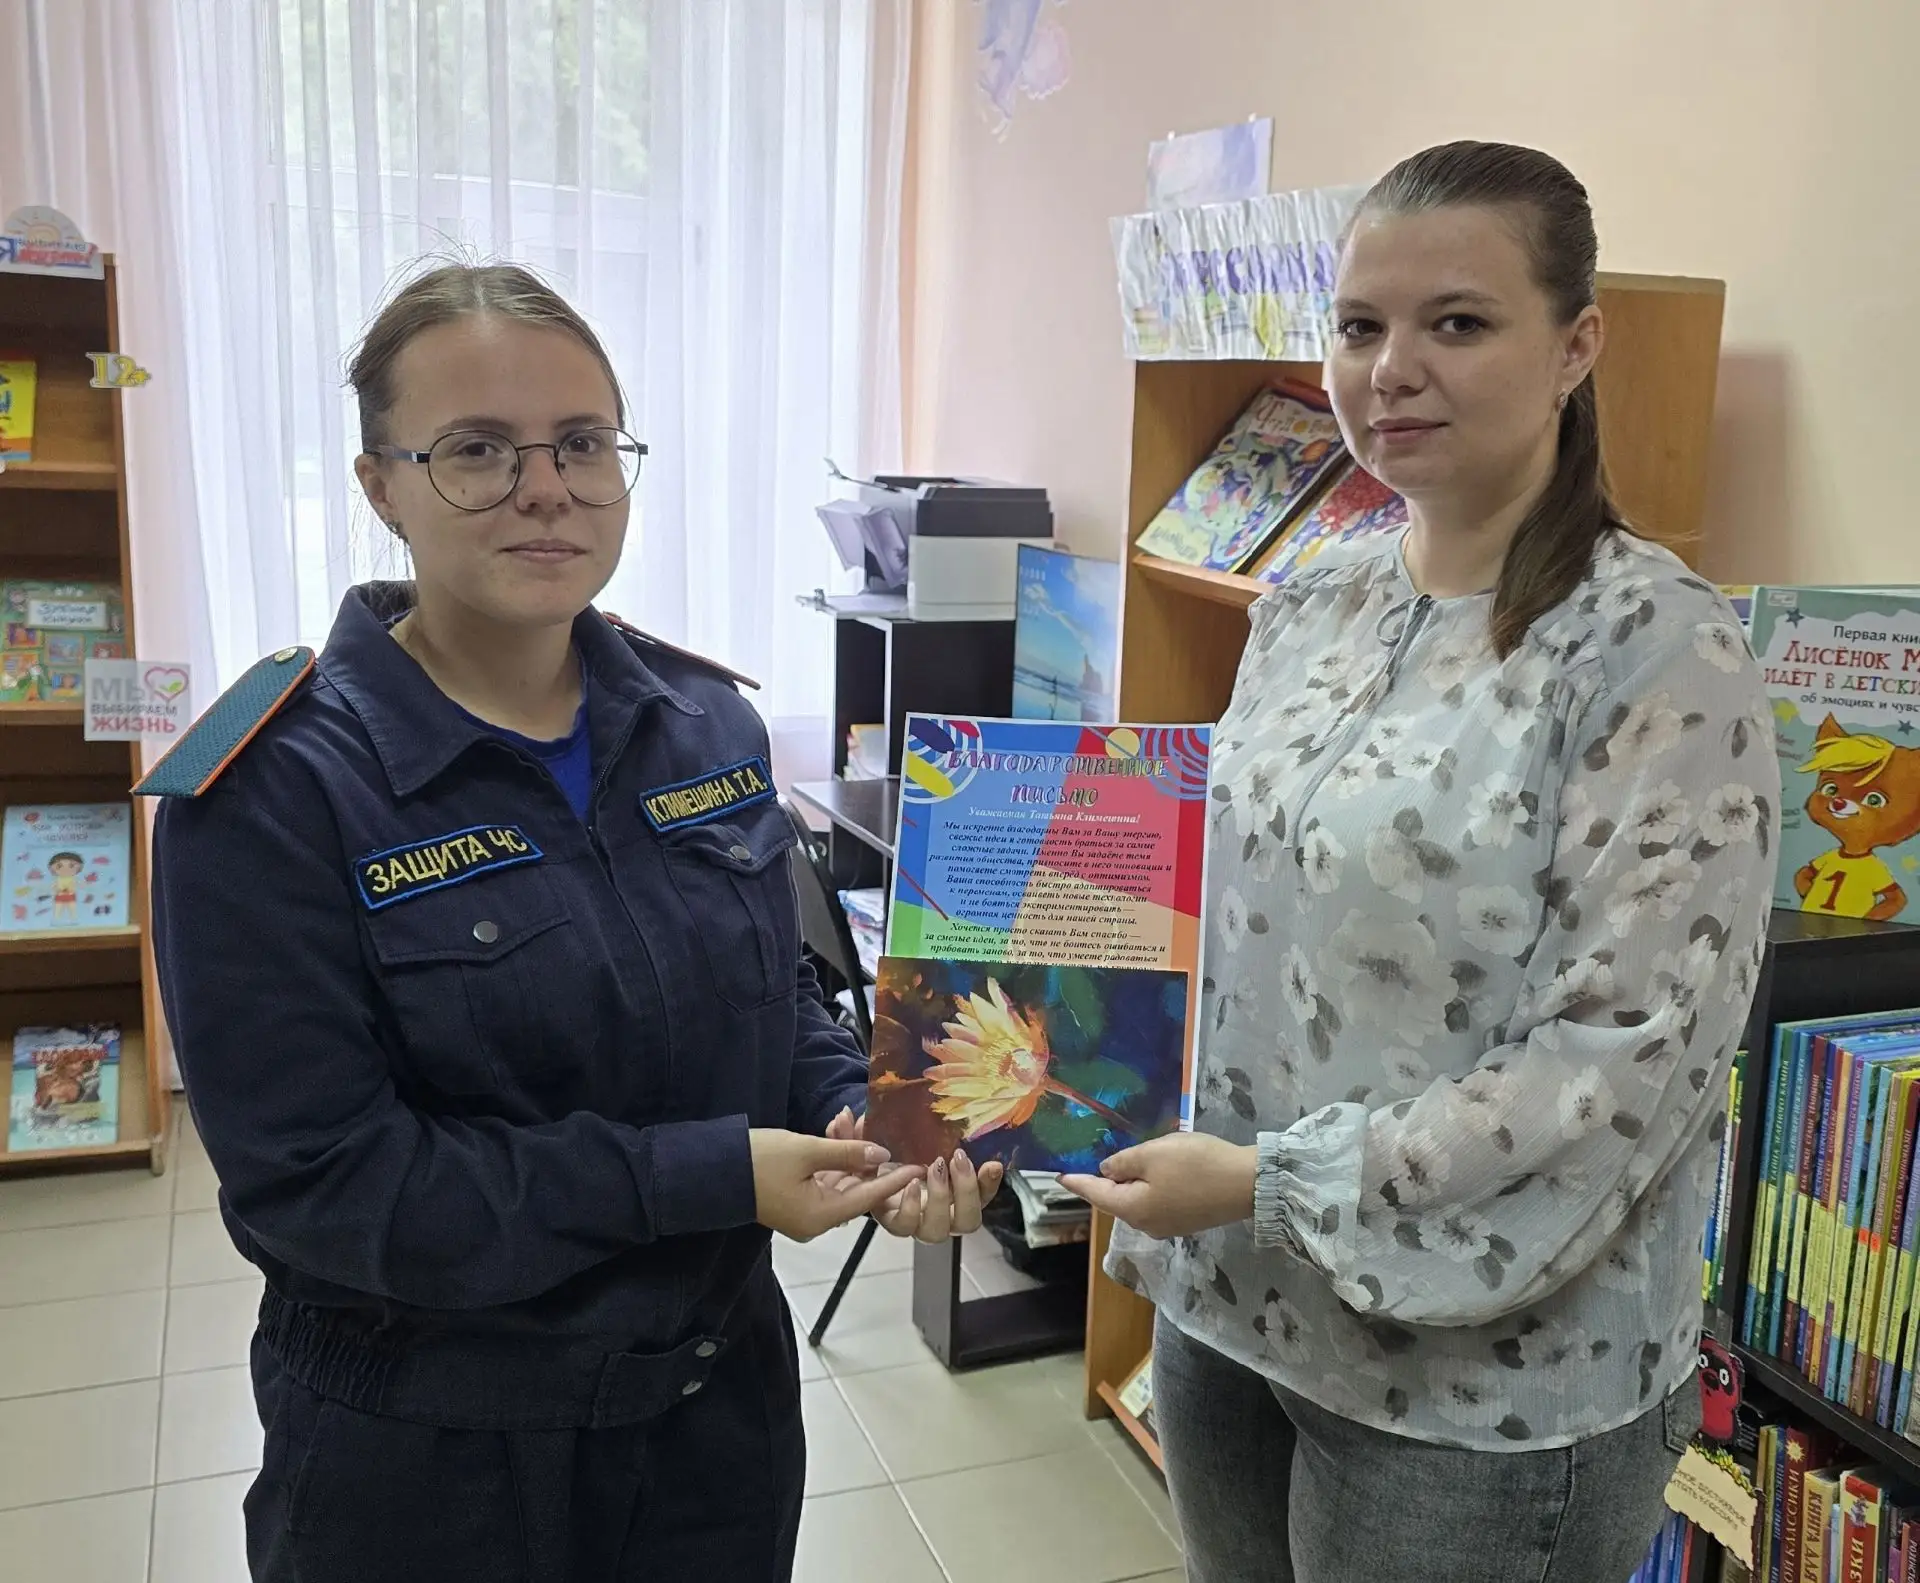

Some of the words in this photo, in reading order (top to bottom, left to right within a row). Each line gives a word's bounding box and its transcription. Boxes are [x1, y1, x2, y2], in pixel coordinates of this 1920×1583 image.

[1833, 625, 1887, 643] Первая
[1892, 633, 1920, 644] кни
[1764, 668, 1817, 688] ИДЁТ
[1824, 673, 1836, 689] В
[90, 702, 178, 716] ВЫБИРАЕМ
[1800, 693, 1817, 703] об
[1821, 695, 1875, 709] эмоциях
[1880, 700, 1888, 710] и
[91, 716, 178, 733] ЖИЗНЬ
[946, 750, 1168, 778] БЛАГОДАРСТВЕННОЕ
[646, 776, 738, 825] КЛИМЕШИНА
[734, 767, 769, 794] Т.А.
[1010, 784, 1099, 807] ПИСЬМО
[967, 806, 1024, 819] Уважаемая
[1029, 810, 1072, 821] Татьяна
[1075, 811, 1140, 824] Климешина!
[962, 823, 1003, 833] искренне
[1006, 824, 1058, 836] благодарны
[1061, 827, 1080, 835] Вам
[1095, 829, 1119, 839] Вашу
[1123, 831, 1161, 841] энергию,
[948, 834, 982, 842] свежие
[986, 835, 1007, 843] идеи
[1016, 837, 1072, 846] готовность
[1074, 838, 1112, 848] браться
[1126, 842, 1154, 850] самые
[366, 834, 491, 893] ЗАЩИТА
[492, 828, 529, 852] ЧС
[951, 845, 994, 853] сложные
[996, 847, 1028, 856] задачи.
[1032, 847, 1068, 856] Именно
[1071, 849, 1084, 857] Вы
[1087, 850, 1123, 859] задаёте
[928, 853, 974, 864] развития
[977, 856, 1023, 866] общества,
[1026, 858, 1081, 869] привносите
[1091, 861, 1111, 869] него
[1114, 863, 1162, 872] инновации
[947, 865, 997, 874] помогаете
[999, 868, 1045, 878] смотреть
[1048, 869, 1080, 880] вперёд
[1088, 872, 1149, 881] оптимизмом.
[946, 875, 972, 883] Ваша
[975, 876, 1033, 888] способность
[1036, 880, 1071, 890] быстро
[1073, 882, 1151, 893] адаптироваться
[1820, 870, 1847, 911] 1
[957, 888, 1010, 897] переменам,
[1092, 894, 1147, 903] технологии
[981, 899, 1019, 908] бояться
[1022, 901, 1120, 914] экспериментировать
[955, 909, 999, 919] огромная
[1001, 911, 1045, 920] ценность
[1047, 912, 1063, 921] для
[1066, 914, 1096, 922] нашей
[1098, 916, 1137, 925] страны.
[950, 922, 991, 932] Хочется
[993, 926, 1027, 935] просто
[1029, 927, 1066, 936] сказать
[1069, 928, 1088, 937] Вам
[1090, 929, 1127, 939] спасибо
[936, 934, 970, 942] смелые
[973, 935, 996, 944] идеи,
[1011, 938, 1025, 946] то,
[1029, 938, 1047, 946] что
[1063, 939, 1101, 949] боитесь
[1103, 941, 1157, 952] ошибаться
[930, 944, 979, 954] пробовать
[982, 947, 1013, 956] заново,
[1029, 949, 1045, 958] то,
[1047, 950, 1066, 958] что
[1068, 951, 1101, 961] умеете
[1104, 952, 1158, 963] радоваться
[1893, 1194, 1902, 1220] СТАТЬ
[1890, 1224, 1898, 1240] КАК
[1782, 1468, 1800, 1556] КЛАССИКИ
[1806, 1491, 1823, 1543] КНИГА
[1803, 1544, 1821, 1582] ДЛЯ
